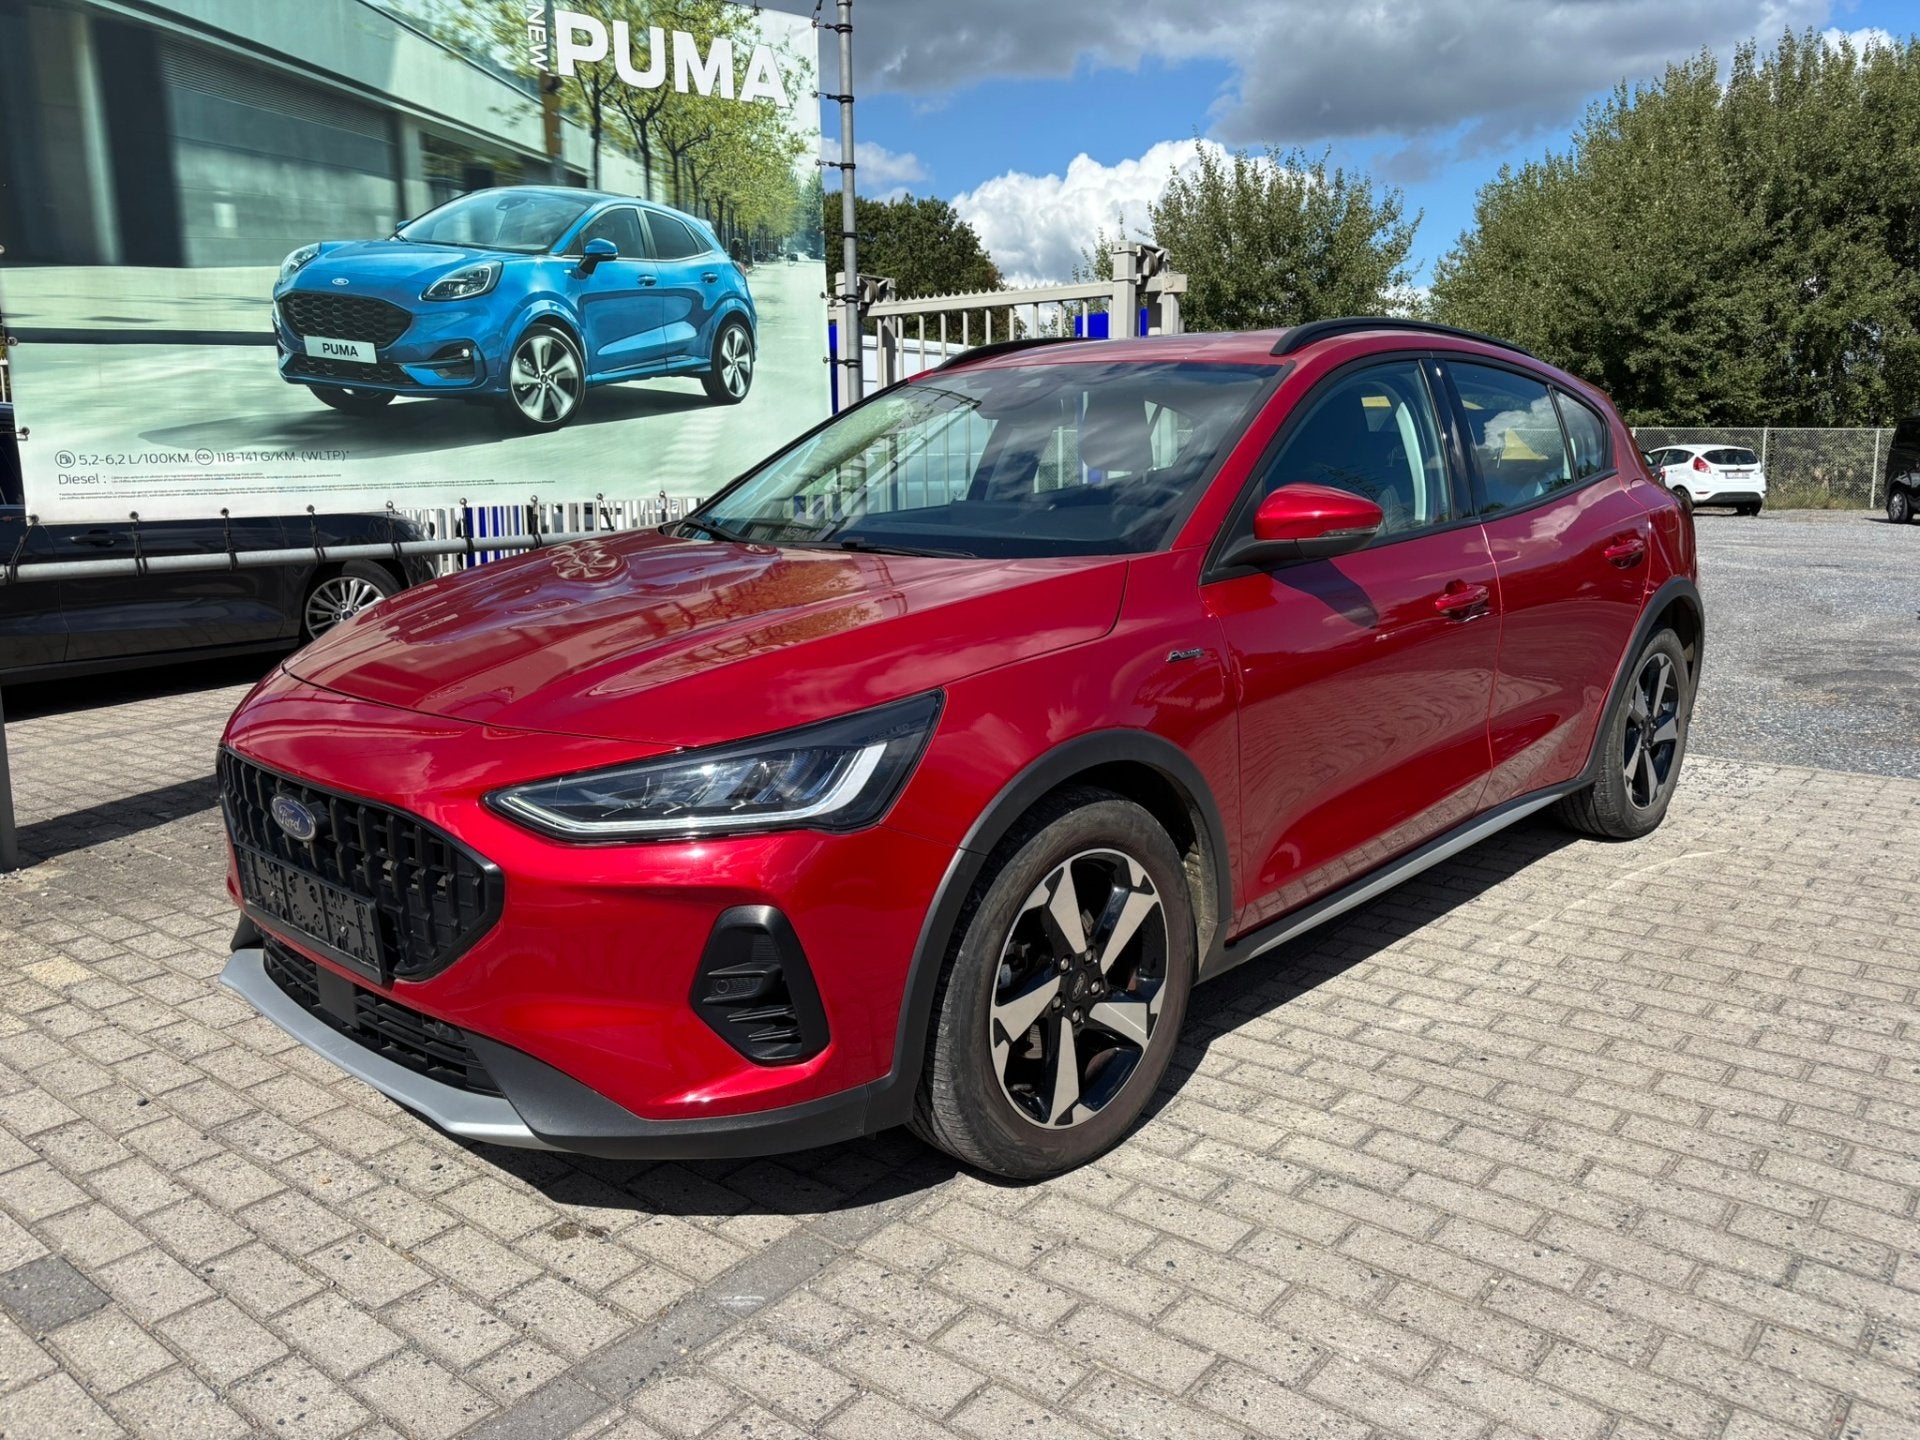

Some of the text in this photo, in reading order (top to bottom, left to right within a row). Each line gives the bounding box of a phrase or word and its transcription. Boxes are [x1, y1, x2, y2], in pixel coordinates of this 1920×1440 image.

[526, 4, 549, 72] NEW
[554, 9, 791, 108] PUMA
[322, 342, 359, 357] PUMA
[128, 452, 193, 465] L/100KM.
[216, 451, 258, 463] 118-141
[260, 450, 299, 462] G/KM.
[58, 472, 100, 485] Diesel
